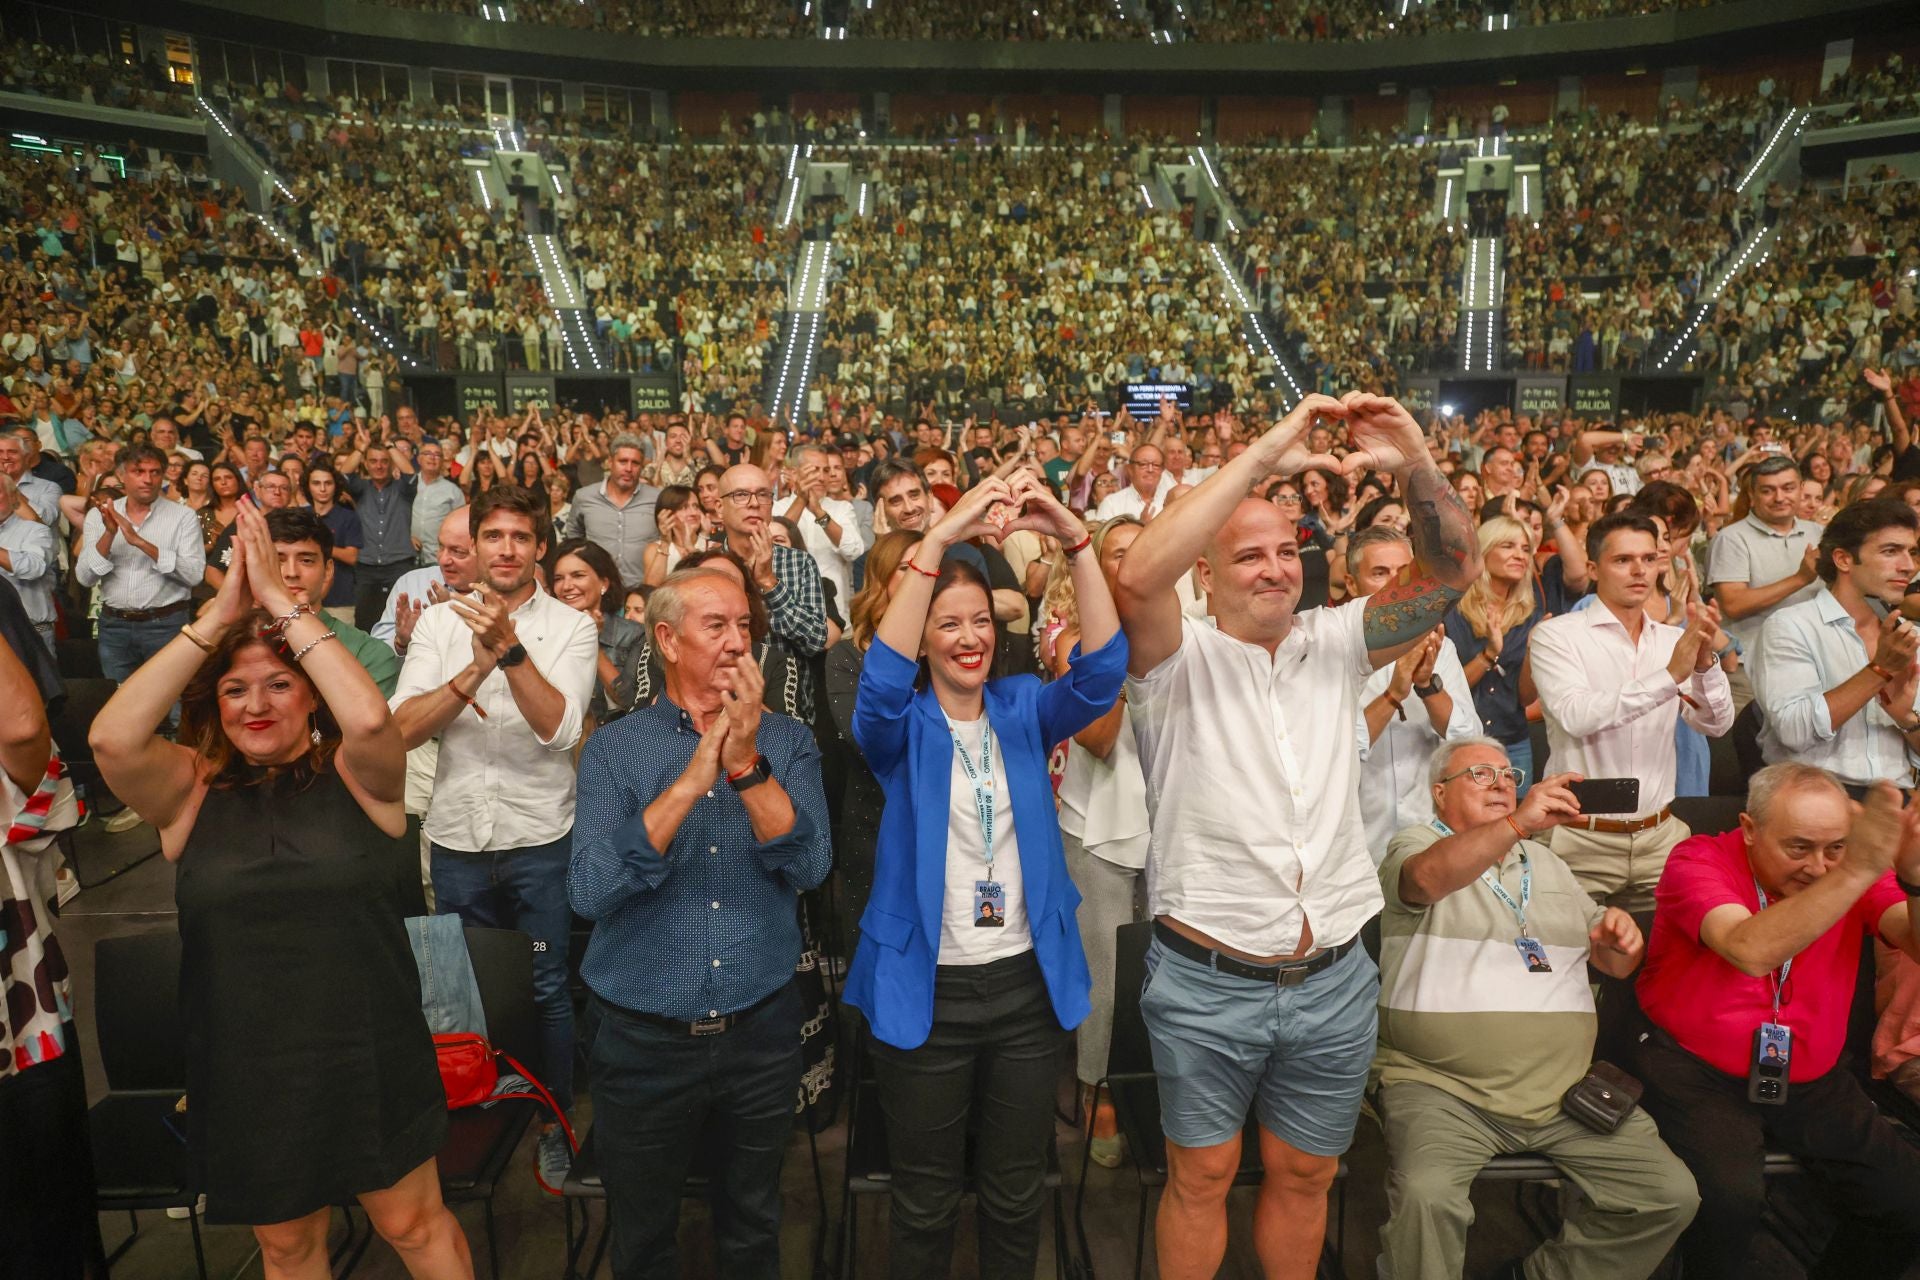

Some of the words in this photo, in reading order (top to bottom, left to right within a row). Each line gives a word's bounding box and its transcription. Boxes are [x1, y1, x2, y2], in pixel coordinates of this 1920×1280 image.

[514, 400, 549, 409] SDA
[638, 399, 670, 409] SALIDA
[1522, 400, 1557, 410] SALIDA
[1576, 400, 1610, 410] SALIDA
[986, 795, 992, 803] 80
[533, 941, 546, 951] 28
